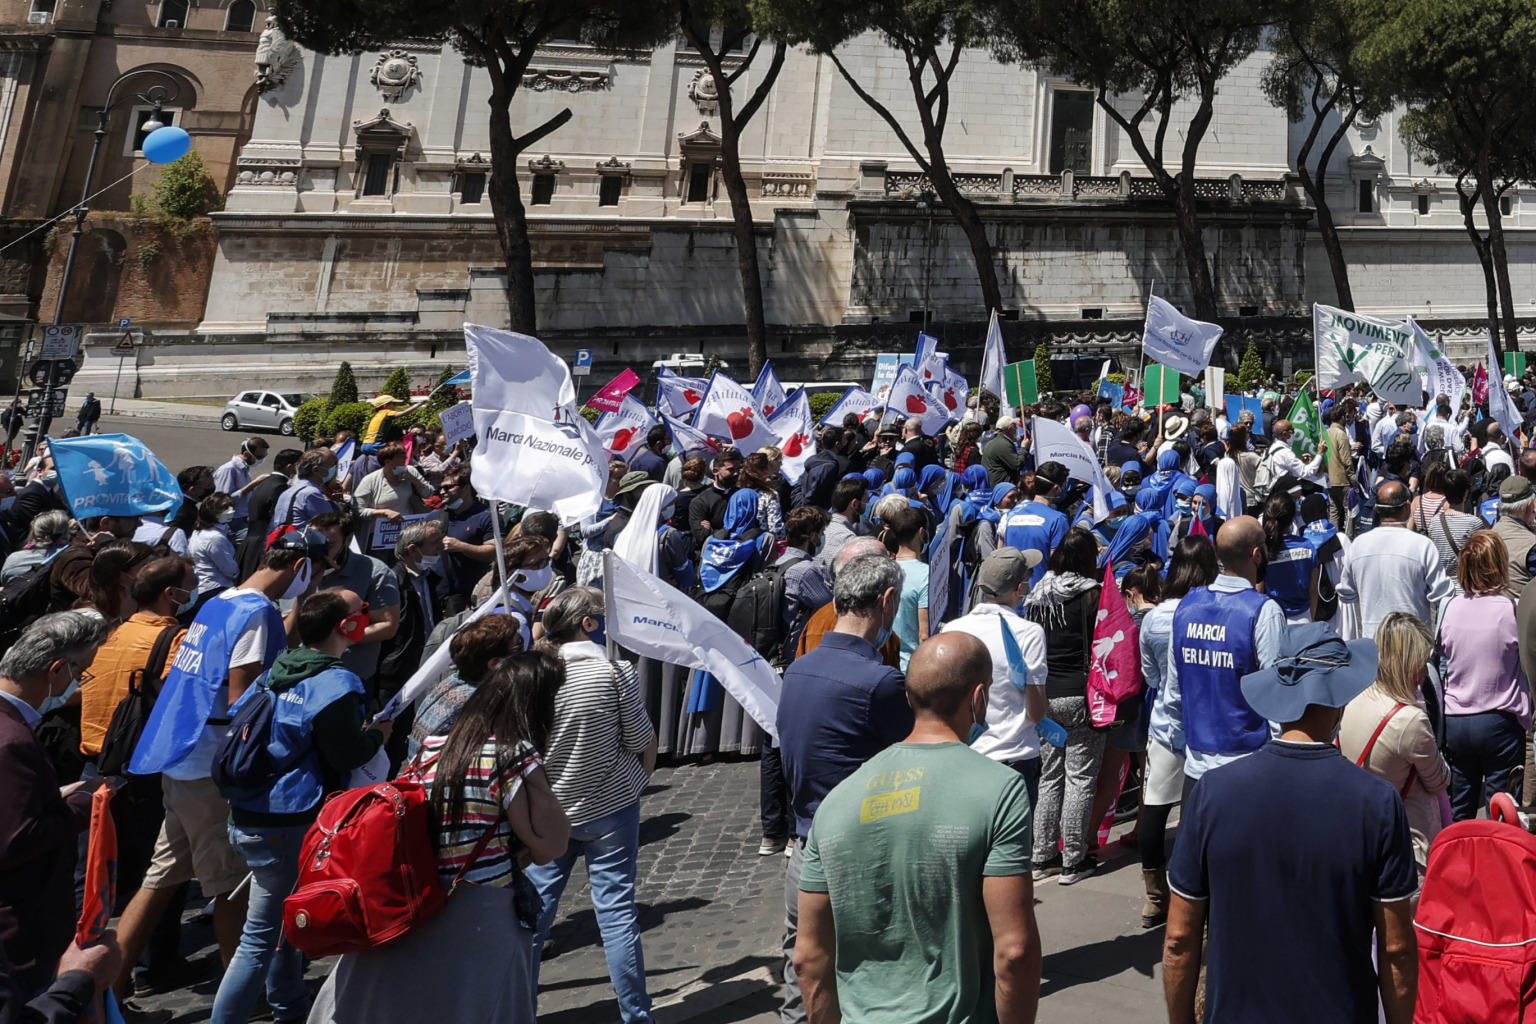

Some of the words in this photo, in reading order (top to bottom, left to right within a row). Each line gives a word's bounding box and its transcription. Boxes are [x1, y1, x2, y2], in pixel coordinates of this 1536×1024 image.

[577, 351, 590, 366] P
[1375, 342, 1395, 357] PER
[523, 435, 584, 461] Nazionale
[1186, 622, 1226, 642] MARCIA
[1198, 649, 1210, 666] LA
[1212, 650, 1234, 669] VITA
[286, 692, 304, 705] Vita
[866, 767, 924, 790] GUESS
